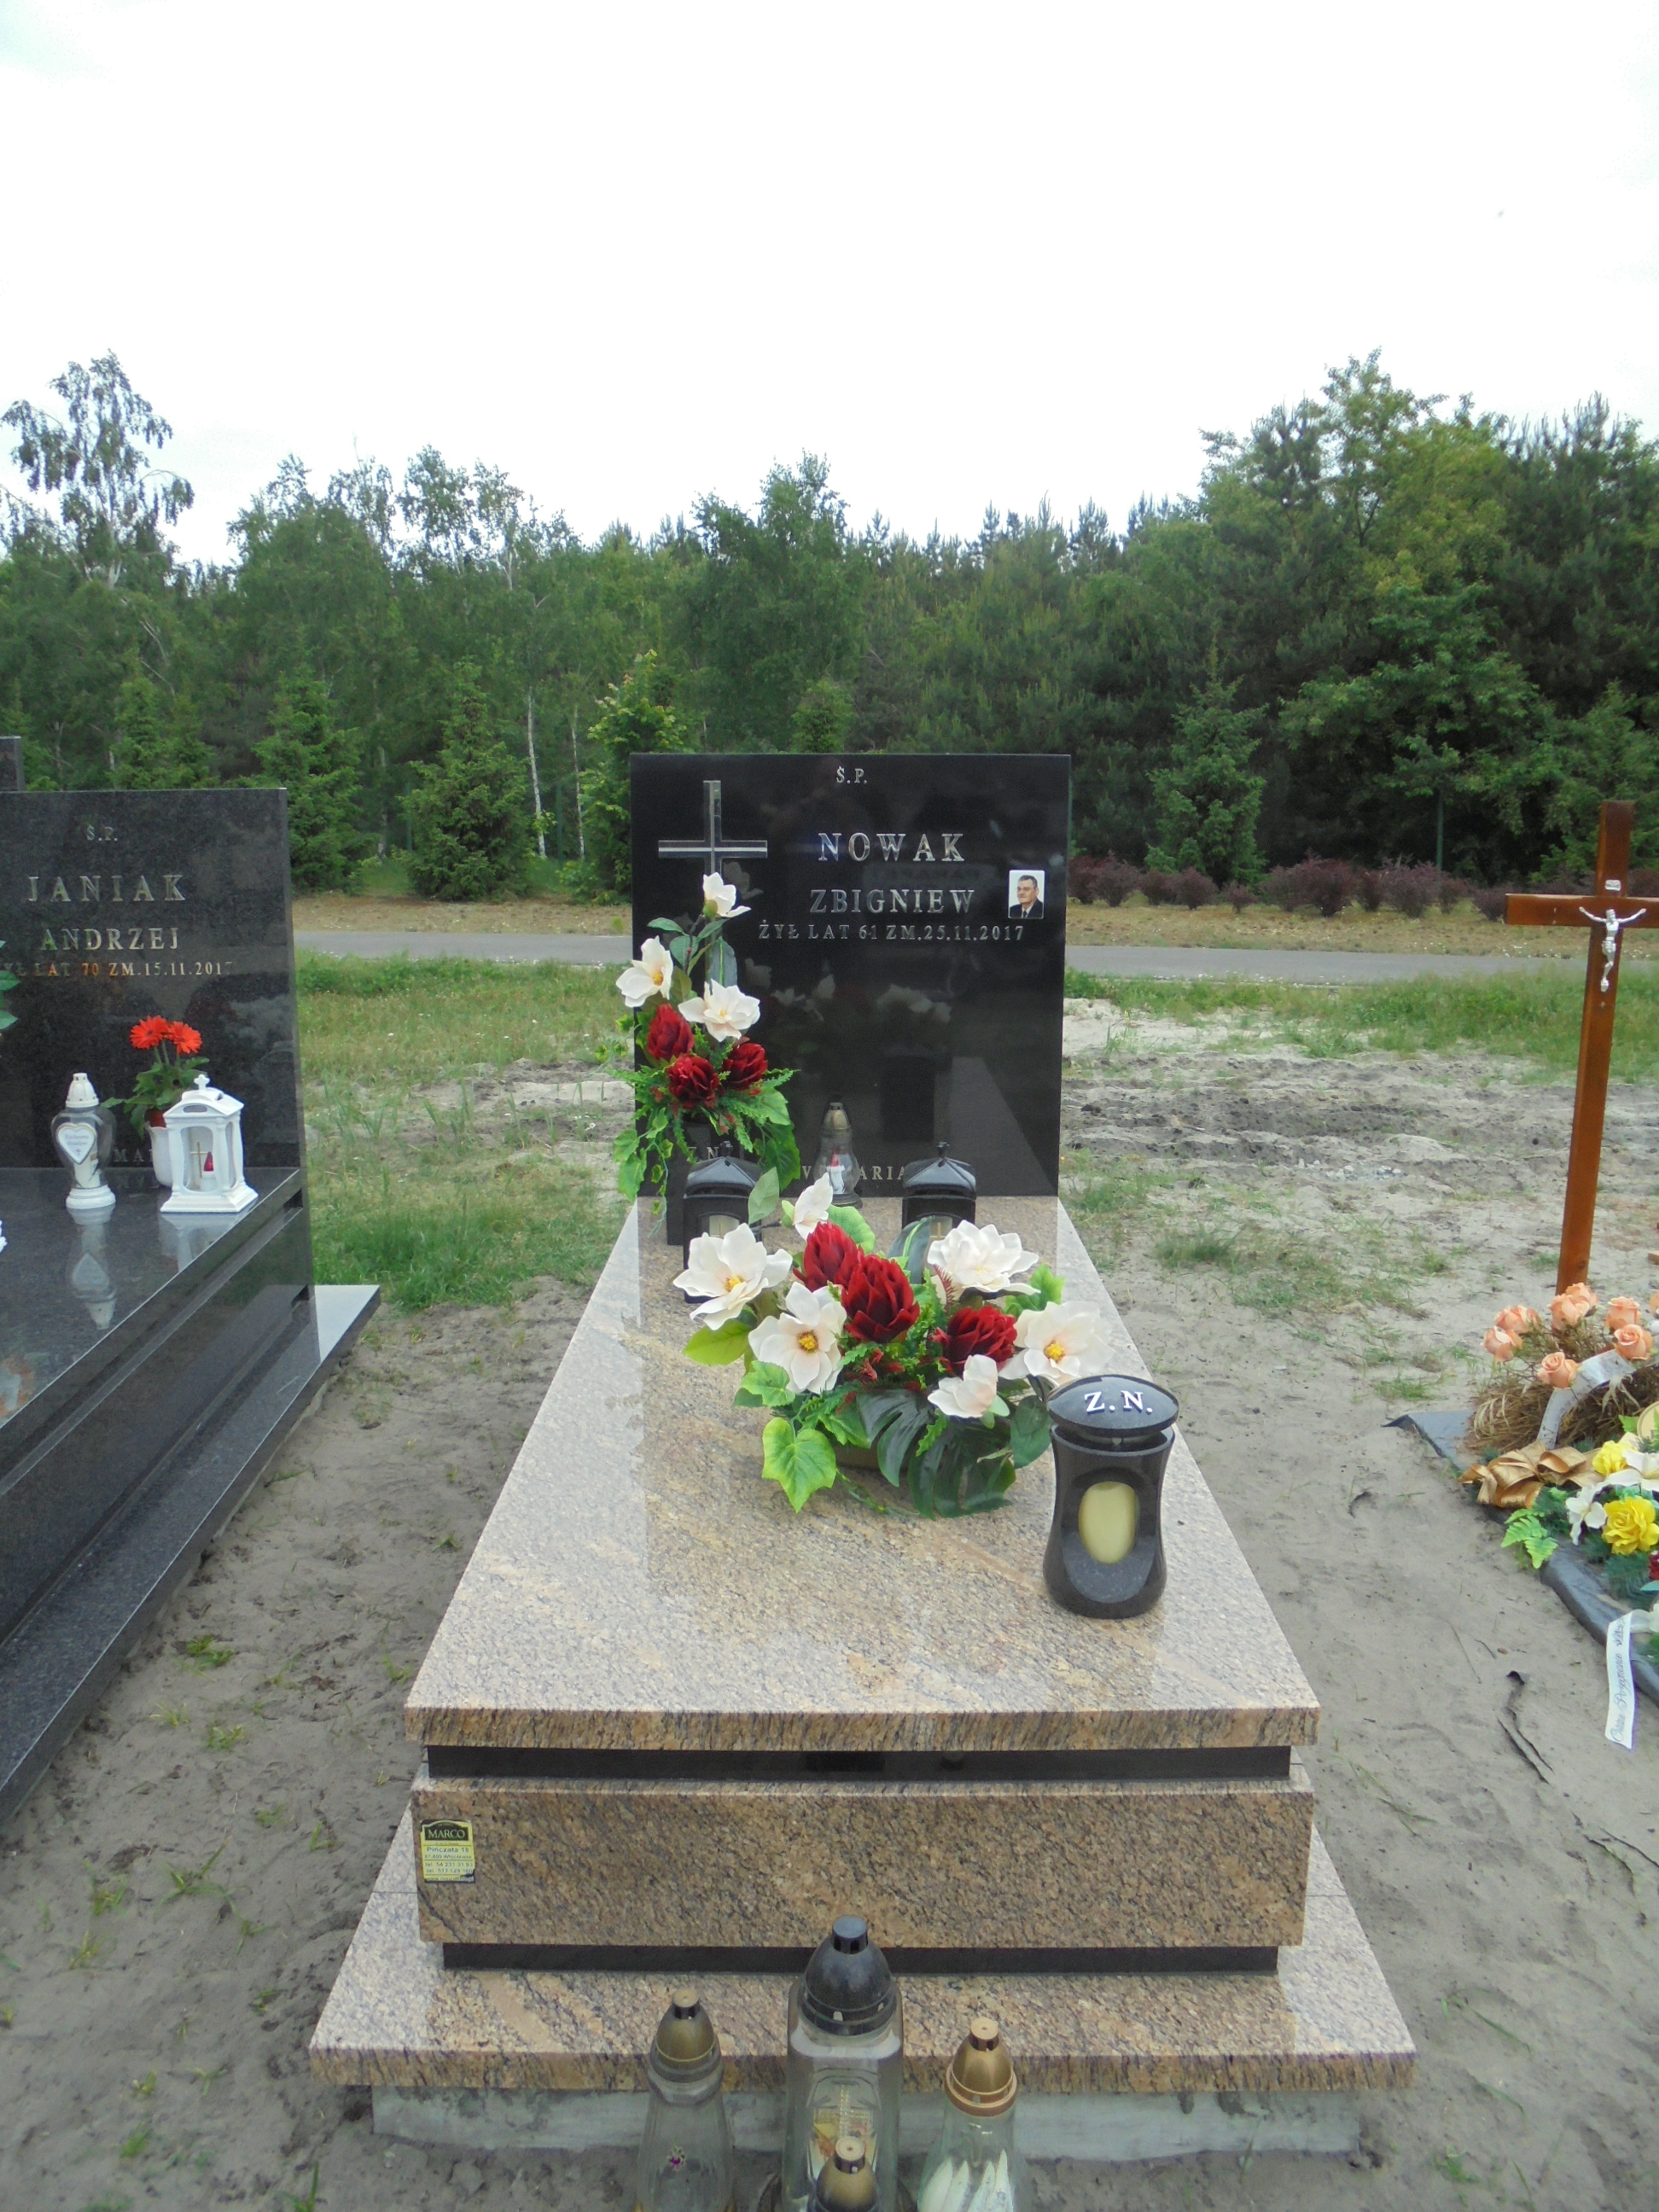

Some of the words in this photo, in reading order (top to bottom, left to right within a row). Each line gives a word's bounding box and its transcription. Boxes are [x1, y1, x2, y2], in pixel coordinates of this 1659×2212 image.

[818, 832, 965, 862] NOWAK
[28, 875, 186, 902] JANIAK
[810, 888, 975, 913] ZBIGNIEW
[40, 928, 178, 950] ANDRZEJ
[759, 919, 800, 940] ŻYŁ
[808, 924, 850, 940] LAT
[859, 924, 877, 940] 61
[35, 963, 70, 977] LAT
[82, 963, 100, 976] 70
[1084, 1390, 1153, 1413] Z.N.
[428, 1829, 465, 1839] MARCO
